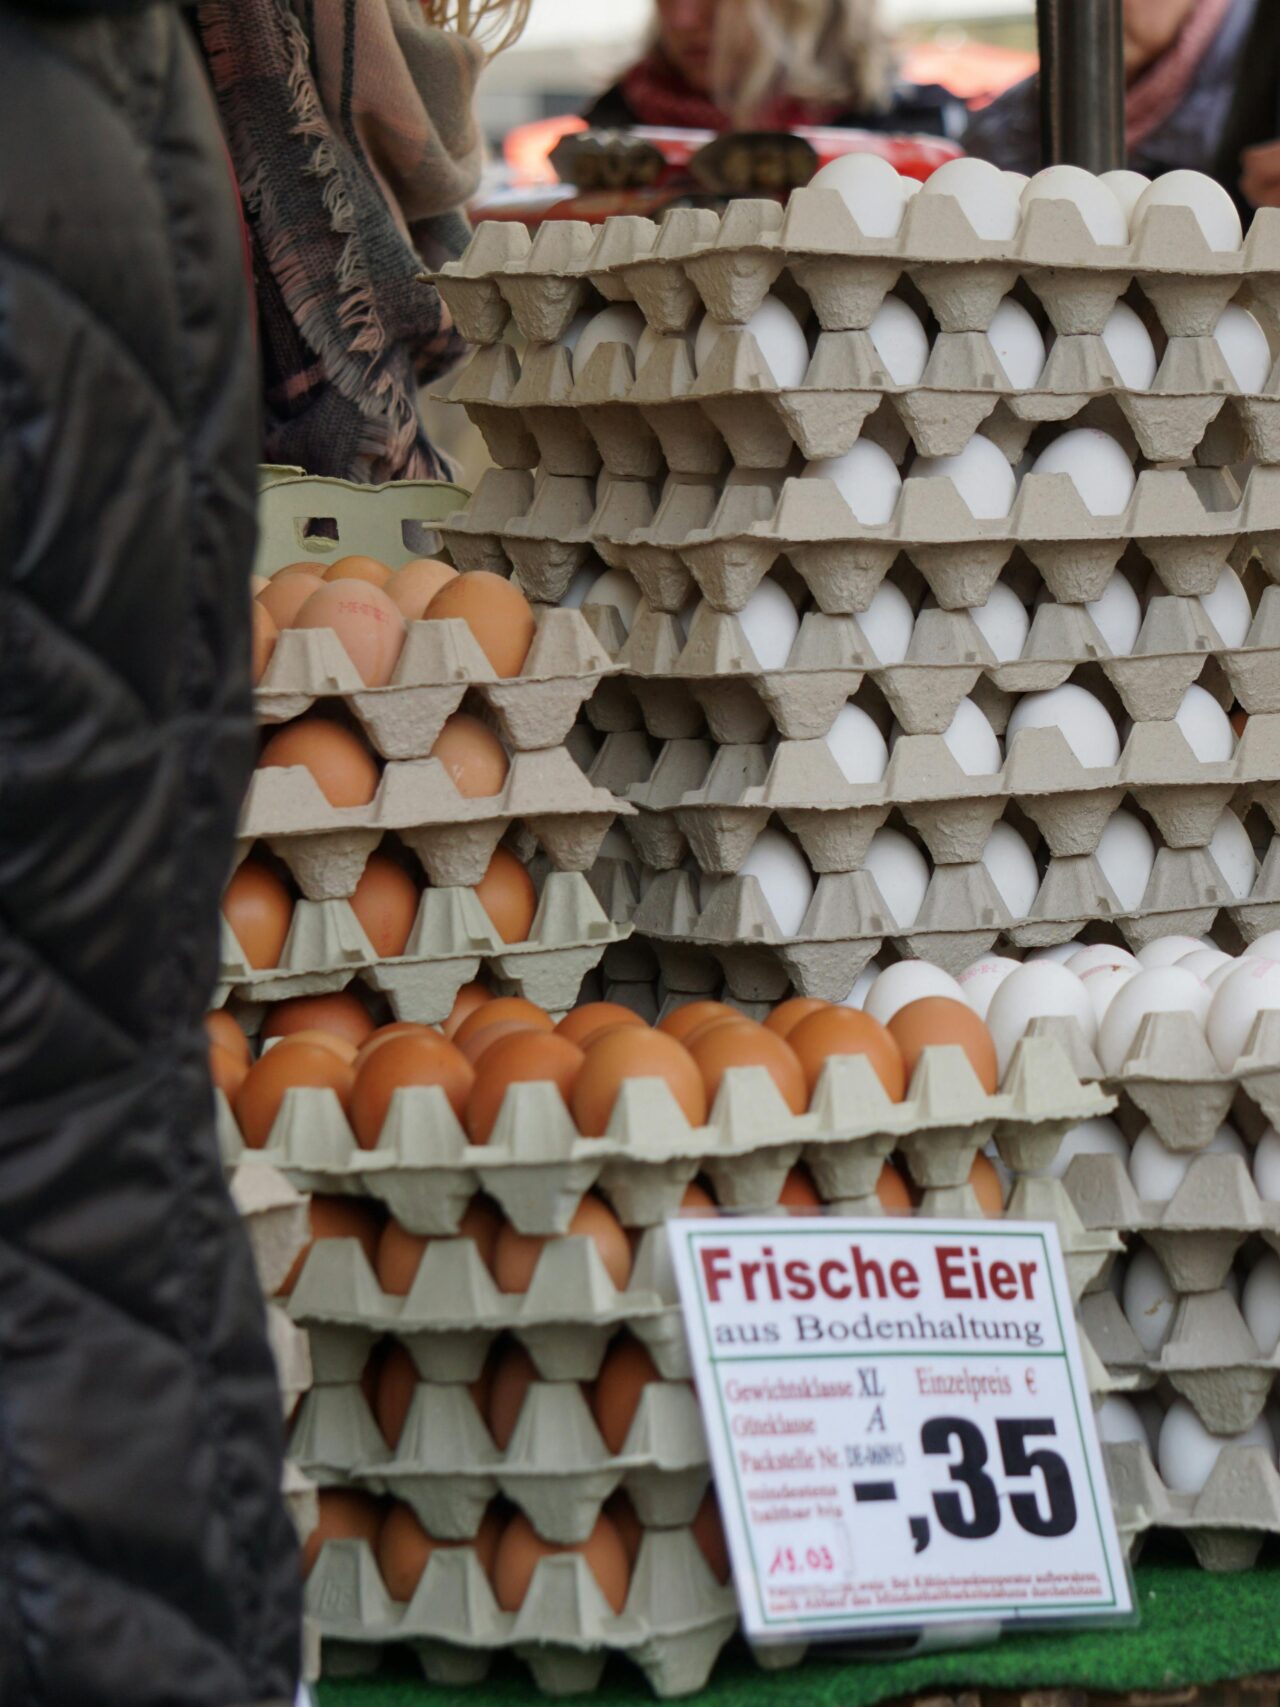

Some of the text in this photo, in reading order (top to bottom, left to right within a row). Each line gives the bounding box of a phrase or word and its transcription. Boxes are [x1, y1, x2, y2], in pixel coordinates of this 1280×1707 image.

[699, 1245, 1038, 1303] Frische Eier
[715, 1313, 1044, 1348] aus Bodenhaltung
[857, 1367, 885, 1398] XL
[914, 1367, 1038, 1402] Einzelpreis €
[866, 1403, 886, 1433] A
